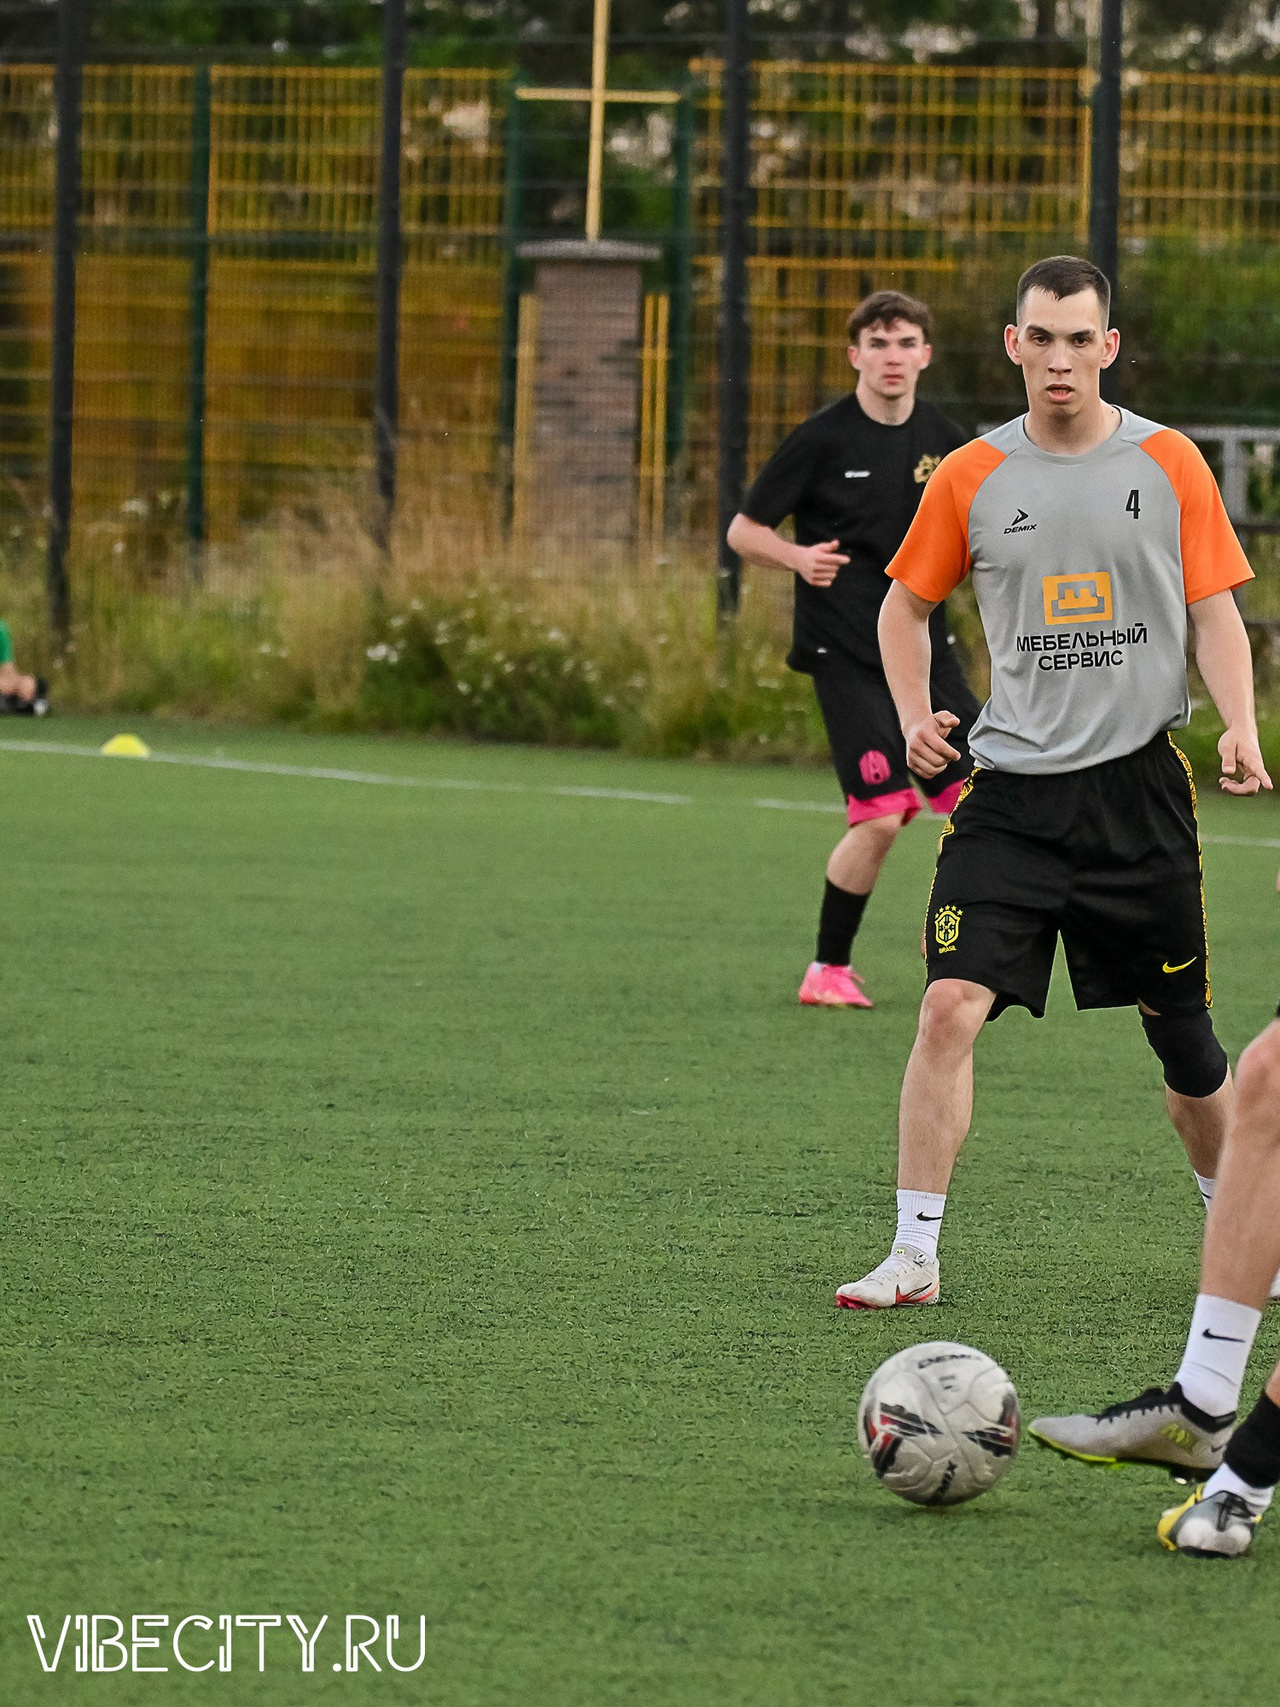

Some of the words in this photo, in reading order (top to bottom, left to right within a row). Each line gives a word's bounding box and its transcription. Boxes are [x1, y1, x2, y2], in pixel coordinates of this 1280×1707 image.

[1125, 489, 1141, 520] 4
[1003, 523, 1038, 535] DEMIX
[1016, 622, 1148, 652] МЕБЕЛЬНЫЙ
[1038, 650, 1124, 671] СЕРВИС
